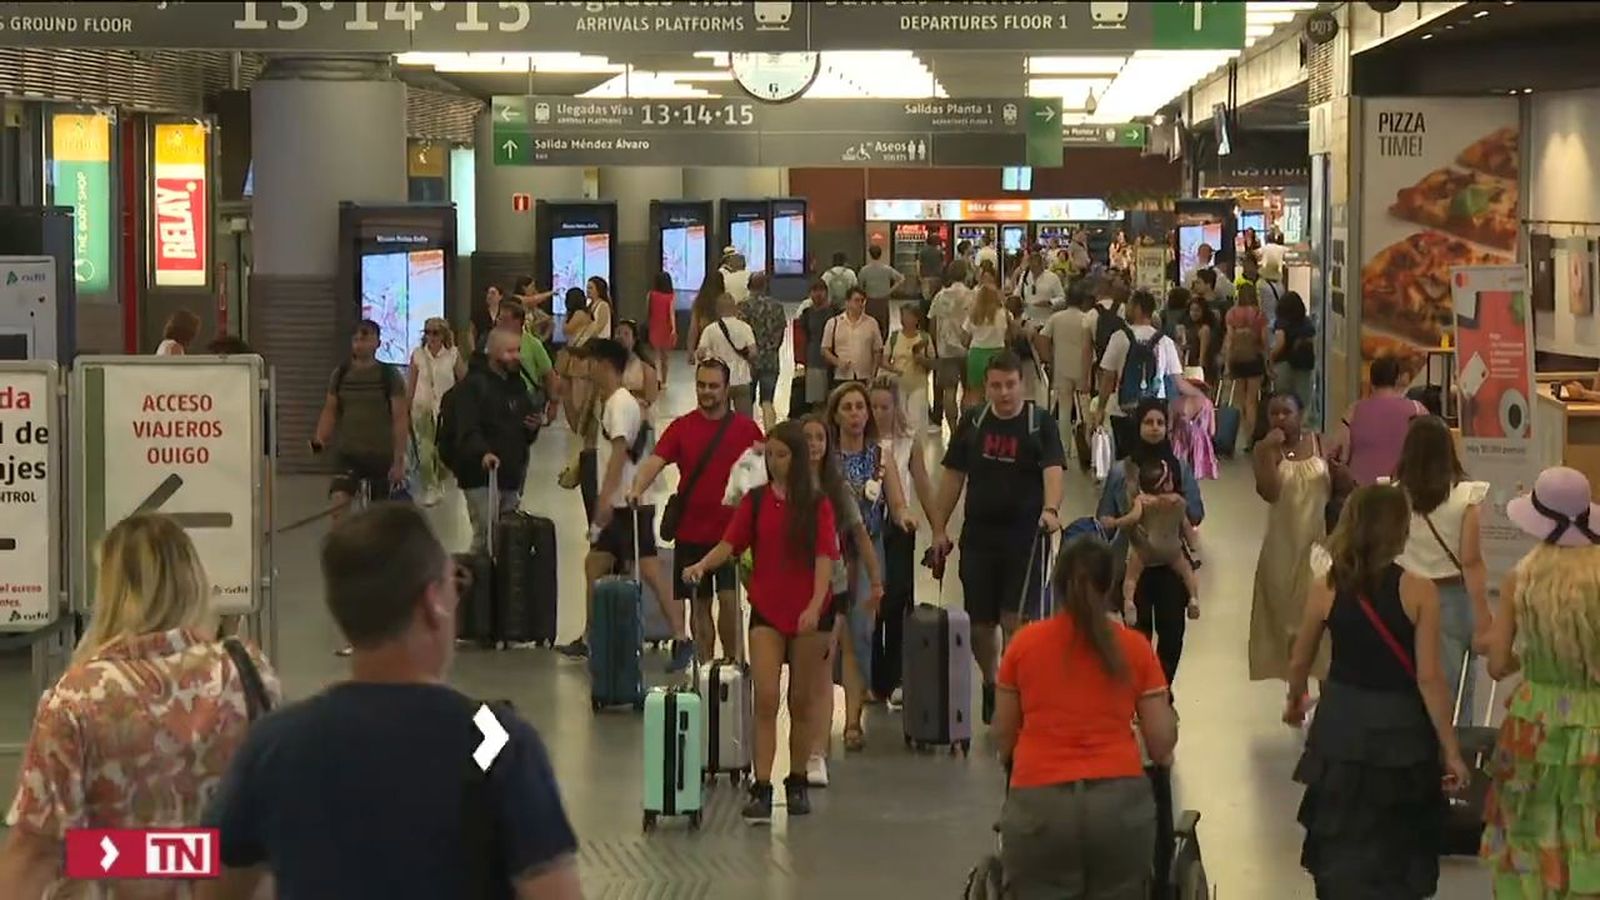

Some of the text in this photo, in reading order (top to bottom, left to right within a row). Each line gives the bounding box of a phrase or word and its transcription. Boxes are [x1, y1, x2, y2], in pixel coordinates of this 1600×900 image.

[10, 16, 77, 31] GROUND
[84, 18, 133, 32] FLOOR
[576, 16, 744, 31] ARRIVALS PLATFORMS
[900, 15, 1068, 30] DEPARTURES FLOOR 1
[769, 83, 779, 93] 6
[557, 104, 607, 117] Llegadas
[905, 104, 993, 114] Salidas Planta 1
[1378, 112, 1426, 133] PIZZA
[534, 138, 650, 149] Salida Méndez Álvaro
[875, 141, 906, 152] Aseos
[1378, 135, 1422, 157] TIME!
[142, 394, 212, 412] ACCESO
[16, 421, 49, 444] de
[132, 420, 222, 438] VIAJEROS
[147, 447, 209, 464] OUIGO
